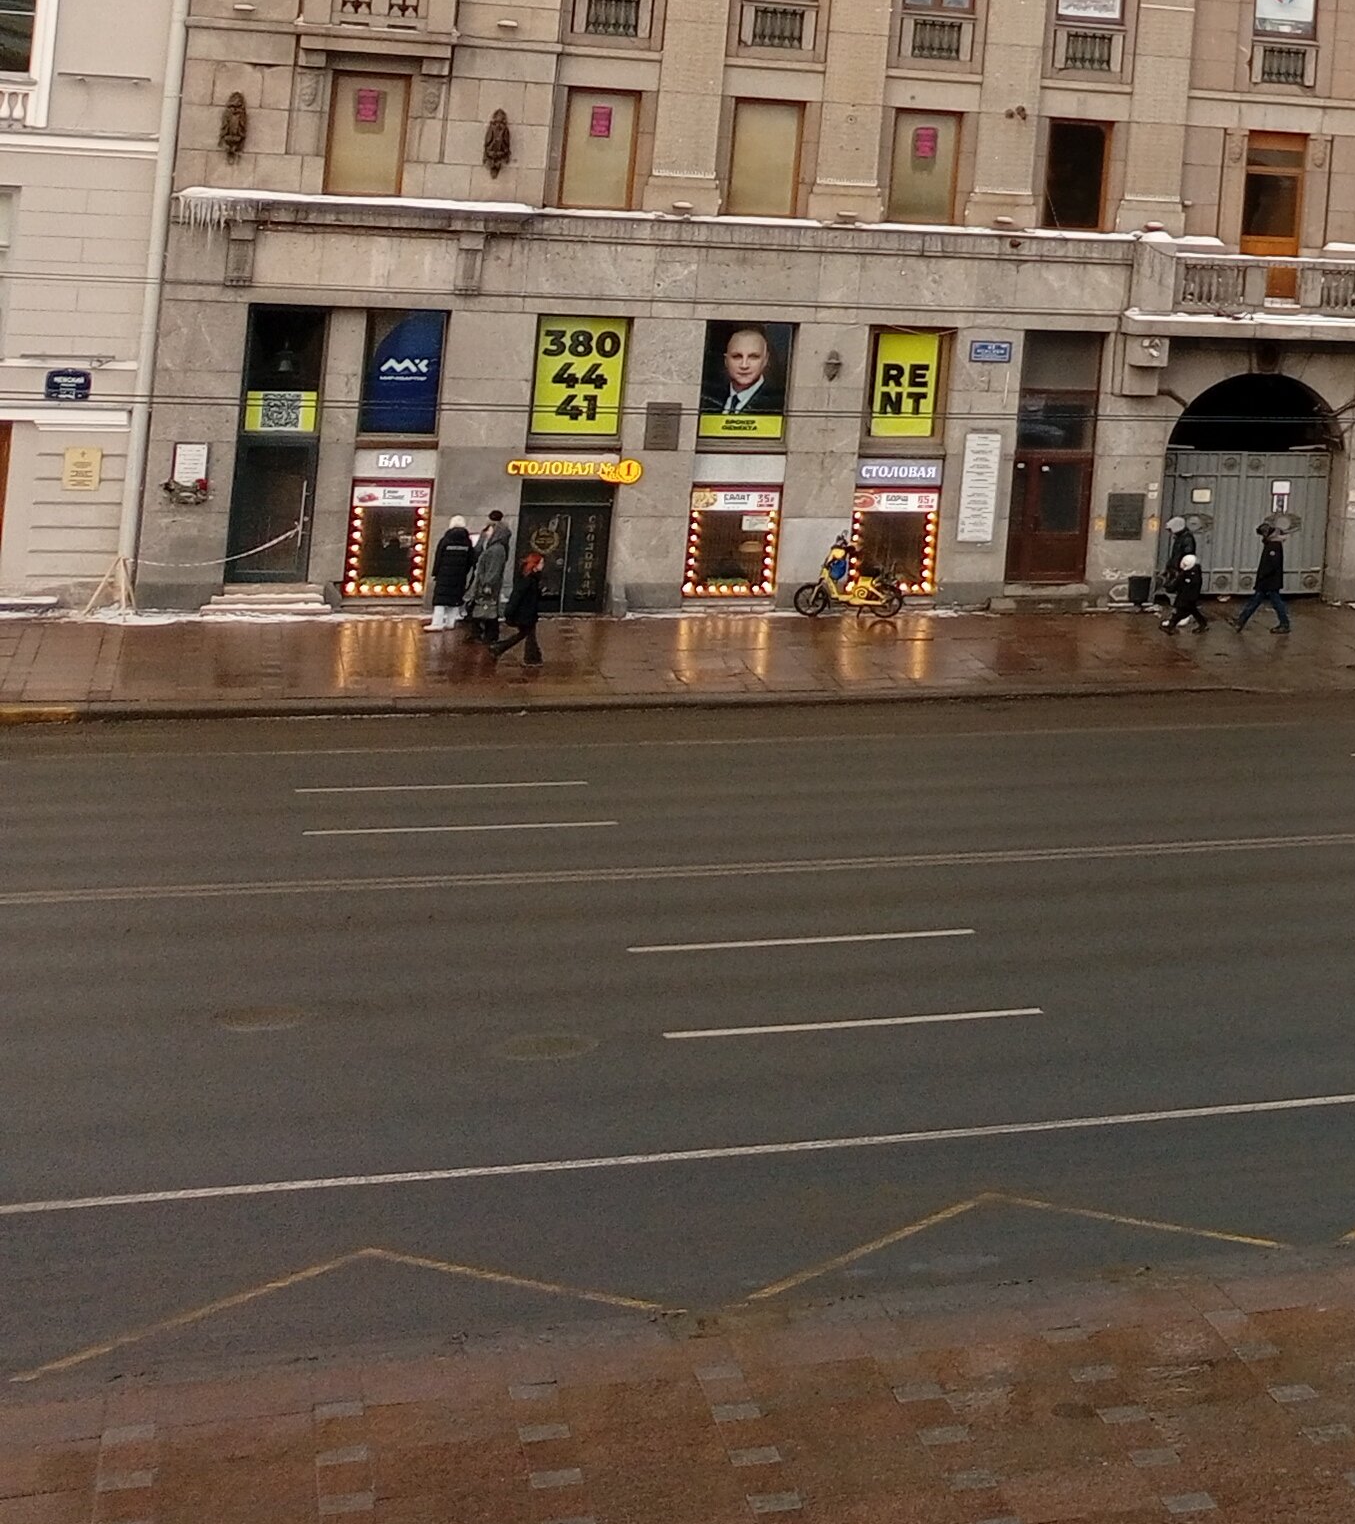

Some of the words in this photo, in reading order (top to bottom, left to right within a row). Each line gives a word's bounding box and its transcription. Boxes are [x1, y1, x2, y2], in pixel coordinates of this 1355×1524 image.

[542, 330, 621, 358] 380
[552, 363, 608, 389] 44
[881, 363, 930, 388] RE
[555, 394, 598, 421] 41
[879, 391, 928, 415] NT
[378, 454, 413, 468] БАР
[508, 460, 595, 475] СТОЛОВАЯ
[861, 464, 937, 479] СТОЛОВАЯ
